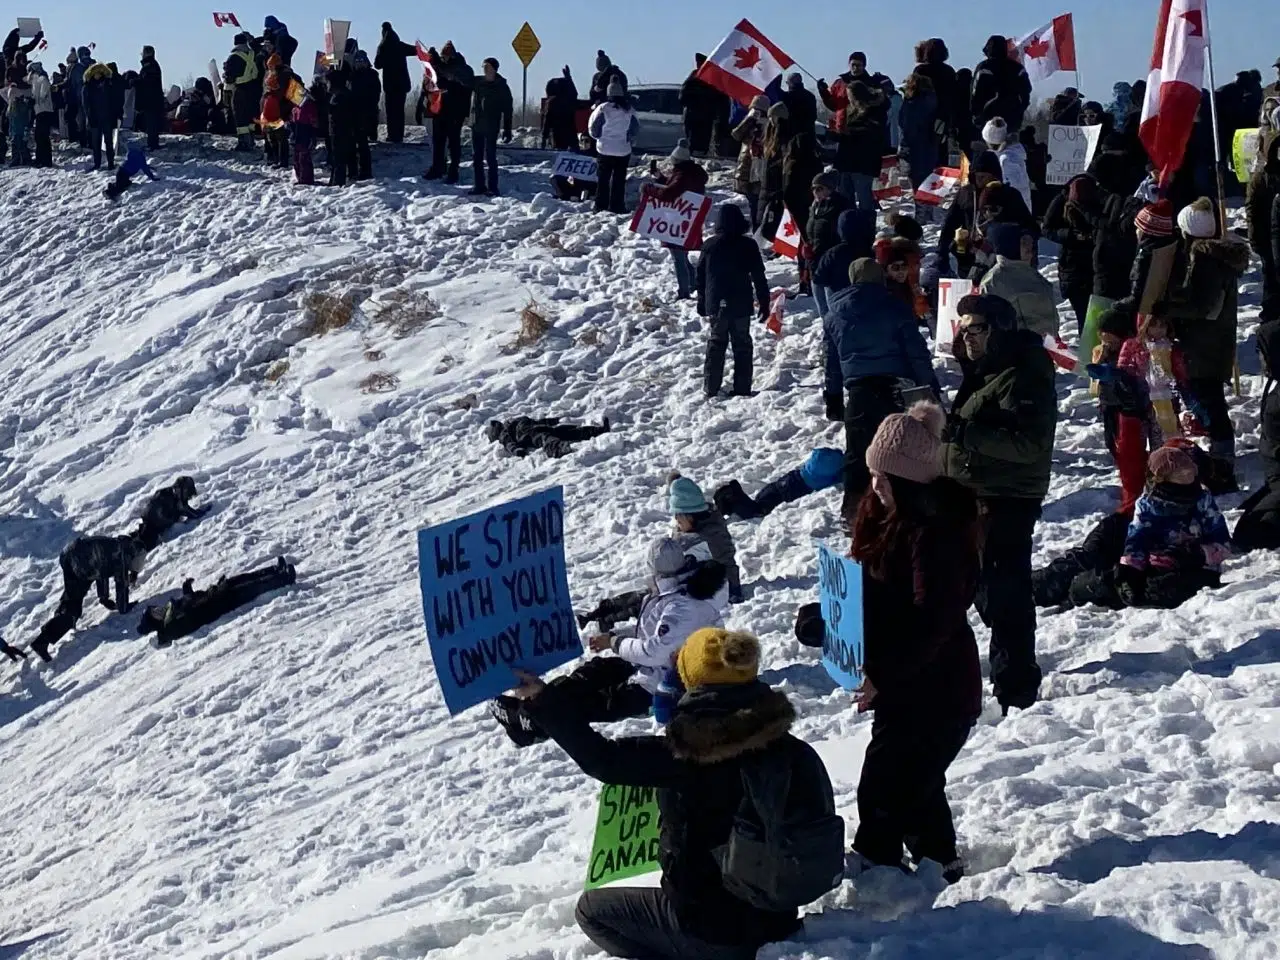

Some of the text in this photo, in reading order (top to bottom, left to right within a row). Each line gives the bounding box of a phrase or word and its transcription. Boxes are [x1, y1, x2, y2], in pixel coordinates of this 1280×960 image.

[556, 157, 597, 176] FREED
[647, 196, 699, 219] TNK
[647, 217, 690, 239] YOU!
[434, 499, 564, 579] WE STAND
[819, 544, 848, 601] STAND
[433, 556, 557, 639] WITH YOU!
[829, 600, 842, 634] UP
[448, 607, 579, 688] CONVOY 2022
[602, 783, 660, 826] STAN
[618, 811, 651, 843] UP
